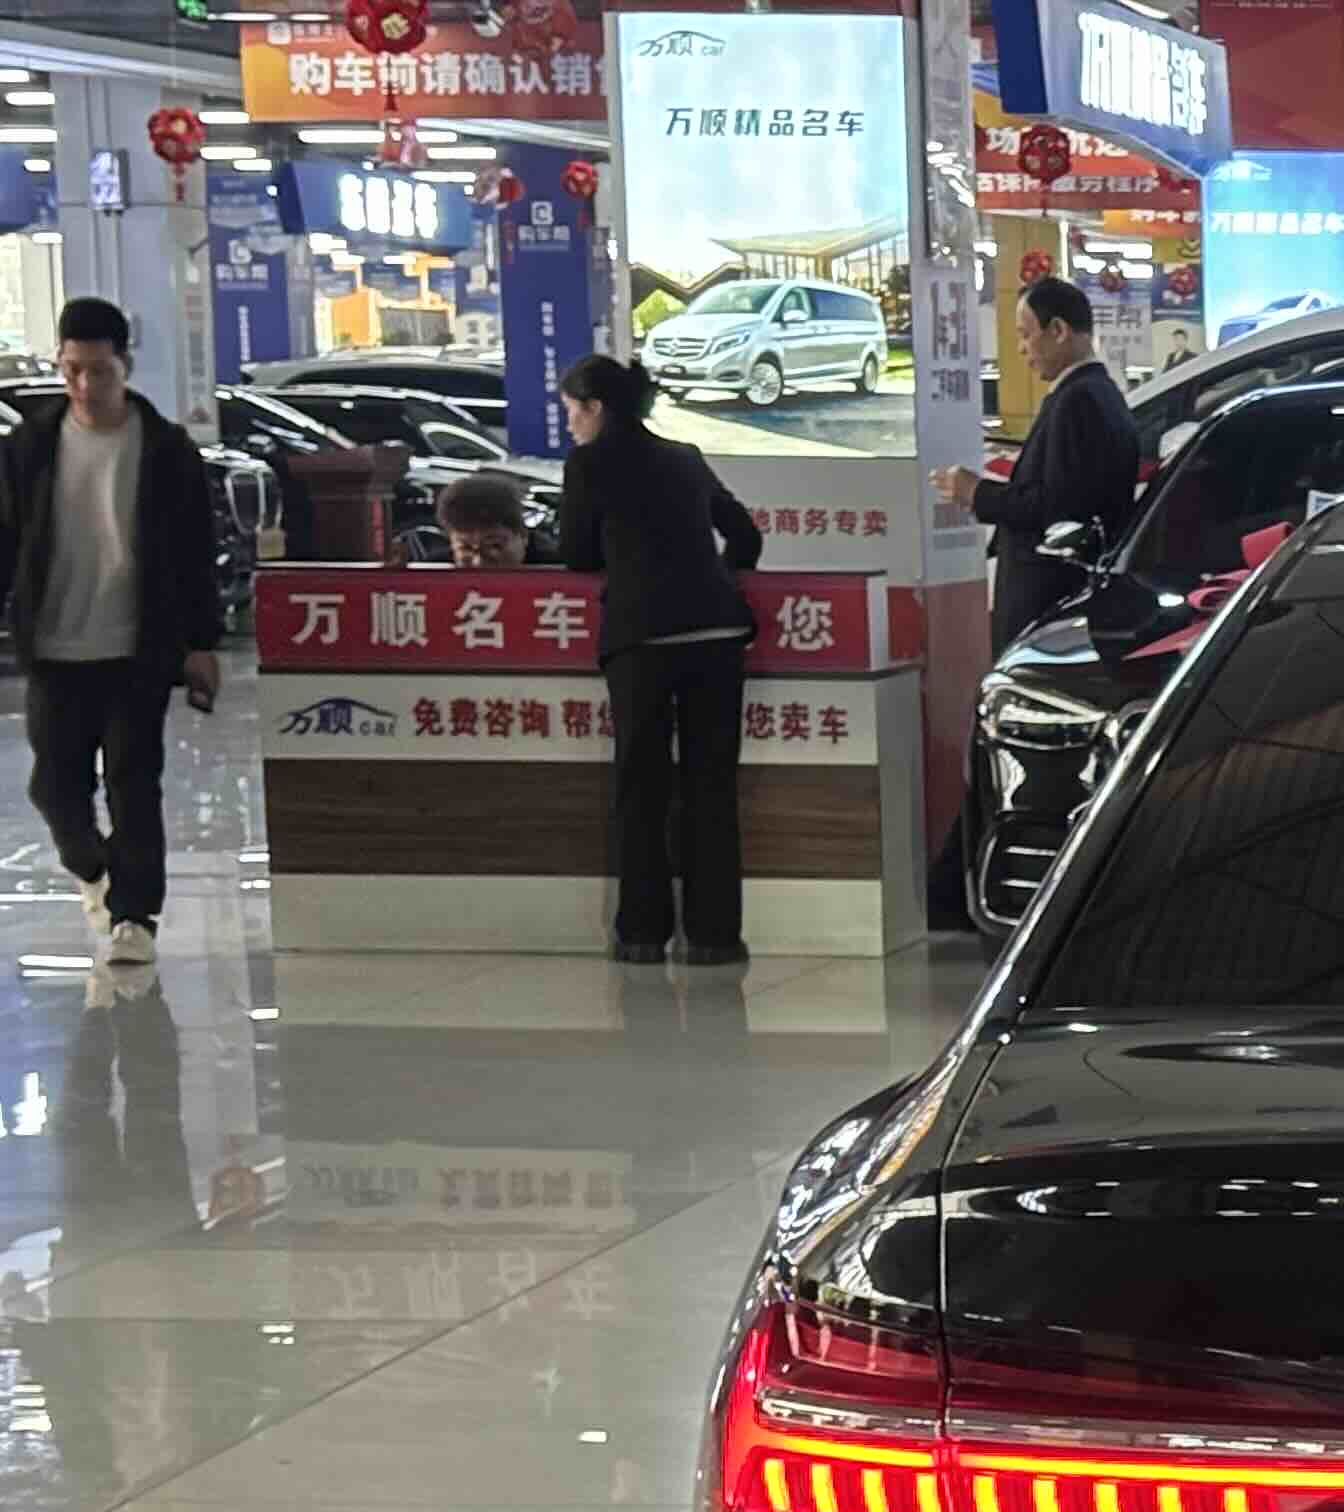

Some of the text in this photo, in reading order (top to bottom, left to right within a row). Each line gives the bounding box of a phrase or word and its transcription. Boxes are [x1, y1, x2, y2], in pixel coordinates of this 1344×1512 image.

[288, 53, 607, 96] 购车前请确认销
[666, 107, 865, 137] 万顺精品名车
[289, 591, 591, 651] 万顺名车
[412, 699, 551, 738] 免费咨询
